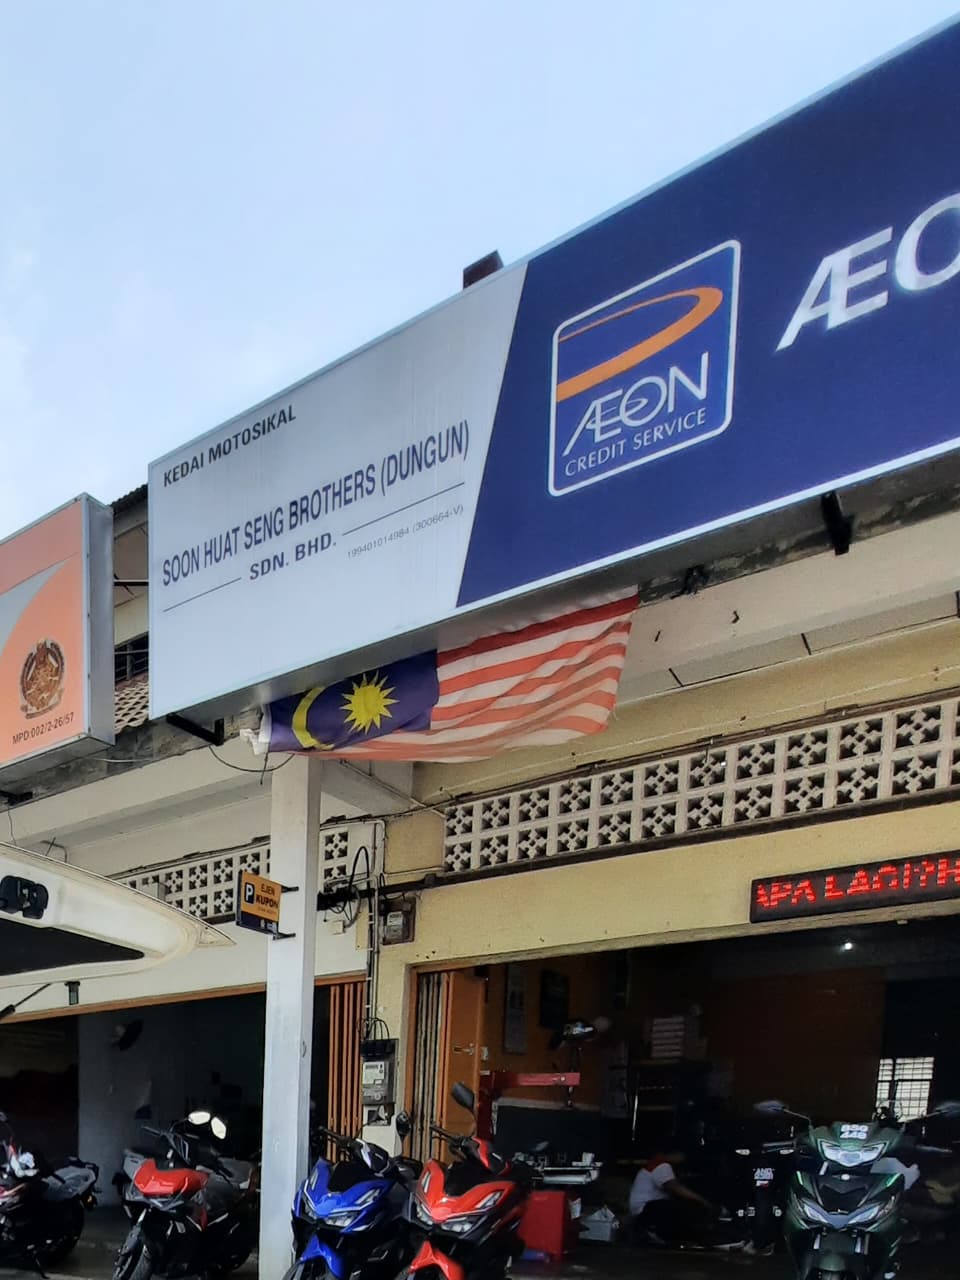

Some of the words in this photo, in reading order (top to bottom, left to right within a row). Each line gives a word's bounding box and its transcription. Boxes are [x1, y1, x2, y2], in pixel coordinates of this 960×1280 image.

[163, 452, 204, 487] KEDAI
[208, 405, 297, 464] MOTOSIKAL
[565, 439, 627, 476] CREDIT
[633, 408, 707, 451] SERVICE
[162, 548, 200, 587] SOON
[203, 526, 240, 569] HUAT
[244, 509, 284, 550] SENG
[289, 463, 376, 531] BROTHERS
[380, 419, 470, 496] (DUNGUN)
[249, 553, 289, 580] SDN.
[295, 532, 337, 562] BHD.
